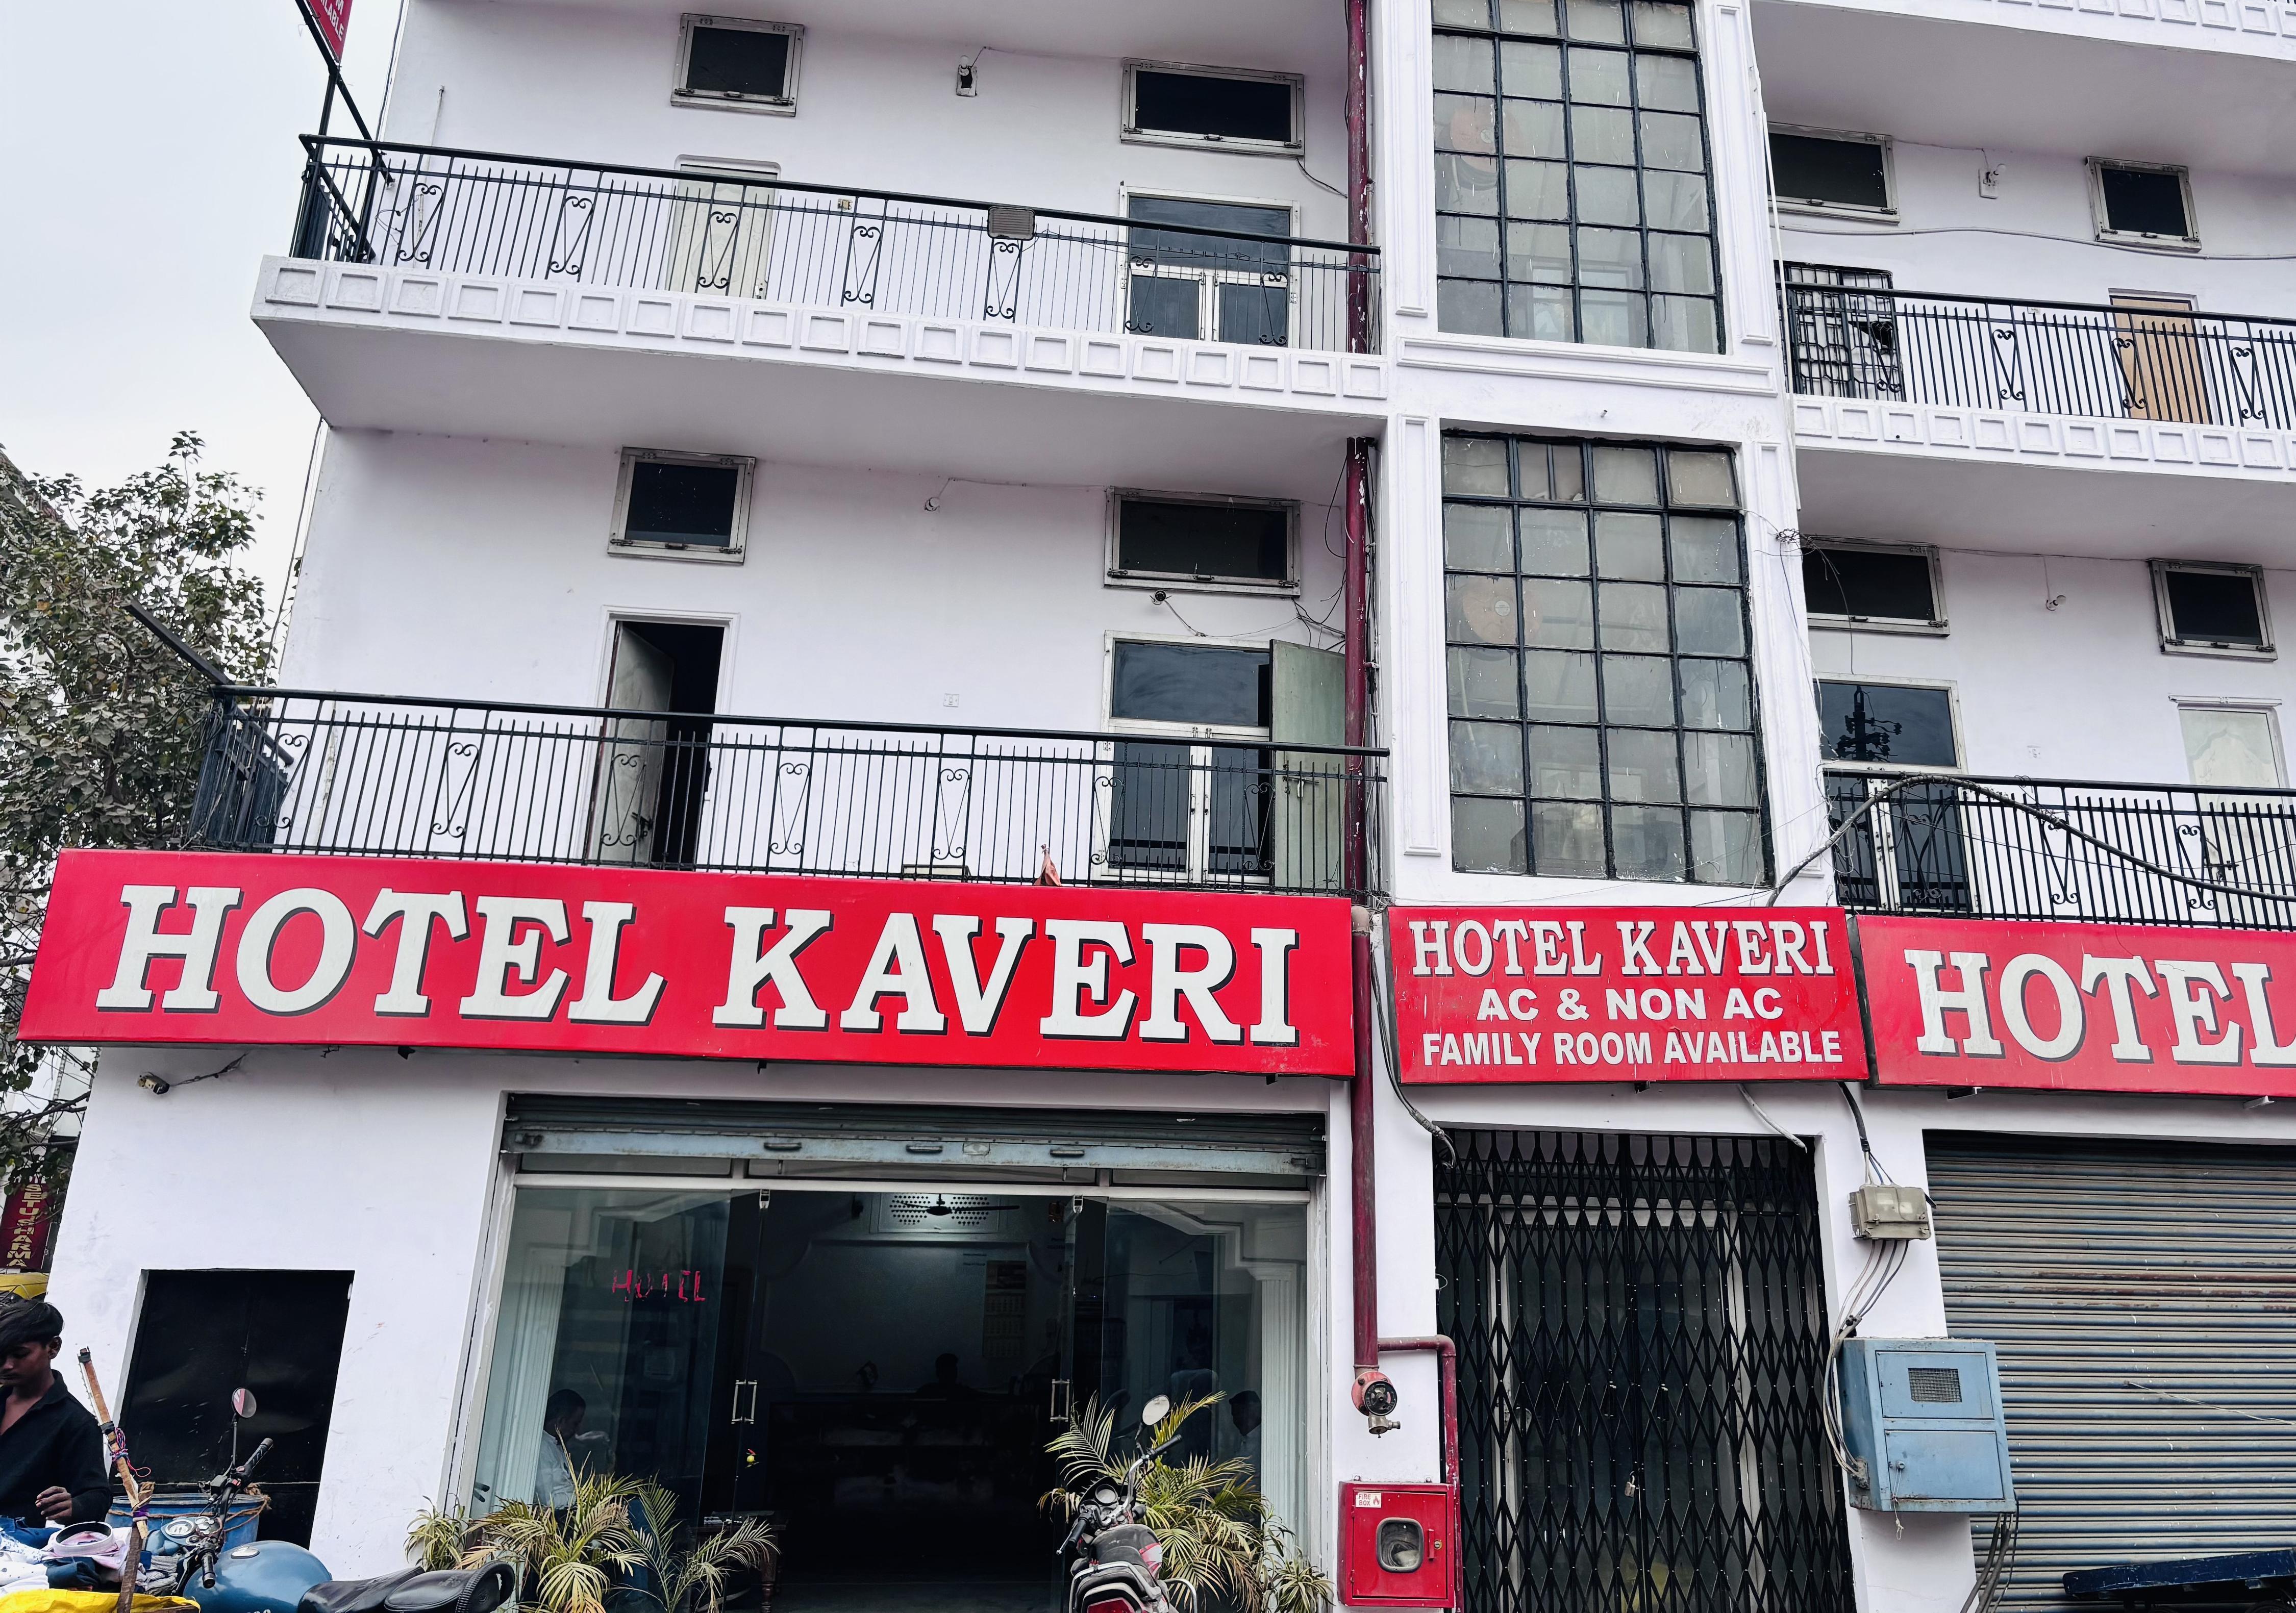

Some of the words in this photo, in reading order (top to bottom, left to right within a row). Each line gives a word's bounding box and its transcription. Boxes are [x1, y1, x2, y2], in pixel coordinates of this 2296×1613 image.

[1408, 919, 1603, 976] HOTEL
[1617, 920, 1835, 976] KAVERI
[96, 885, 667, 1025] HOTEL
[712, 906, 1299, 1046] KAVERI
[1477, 988, 1539, 1021] AC
[1557, 988, 1590, 1020] &
[1605, 988, 1707, 1020] NON
[1723, 988, 1784, 1020] AC
[1422, 1032, 1542, 1066] FAMILY
[1553, 1031, 1653, 1065] ROOM
[1664, 1031, 1843, 1064] AVAILABLE
[19, 1184, 42, 1215] SETU
